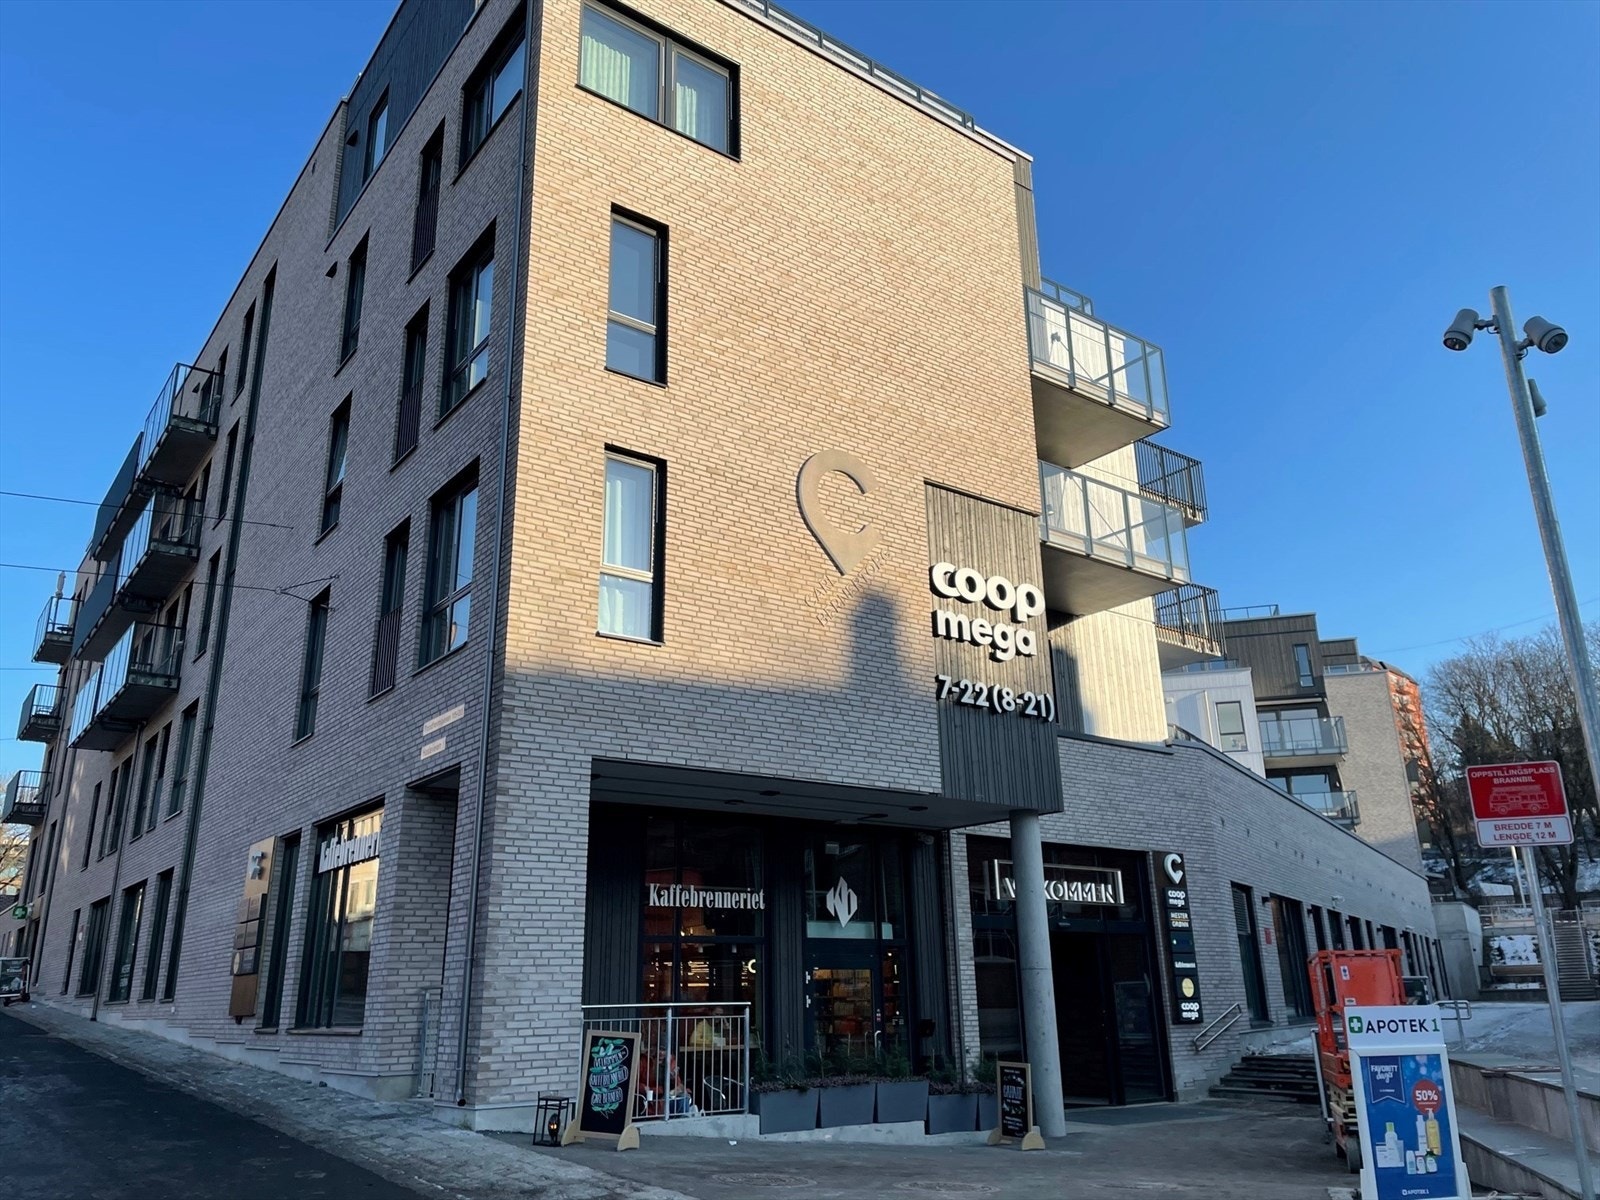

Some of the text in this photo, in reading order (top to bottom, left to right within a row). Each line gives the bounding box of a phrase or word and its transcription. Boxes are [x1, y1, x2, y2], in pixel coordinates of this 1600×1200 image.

[803, 574, 838, 608] CARL
[931, 561, 1046, 623] coop
[933, 609, 1038, 662] mega
[1470, 766, 1556, 778] OPPSTILLINGSPLASS
[1493, 776, 1536, 785] BRANNBIL
[1493, 821, 1553, 831] BREDDE 7 M
[1493, 831, 1557, 841] LENGDE 12 M
[1002, 876, 1116, 904] VKOMMEN
[1168, 890, 1186, 899] coop
[649, 883, 765, 910] Kaffebrenneriet
[1181, 1002, 1200, 1011] coop
[1365, 1018, 1441, 1034] APOTEK 1
[1415, 1089, 1438, 1101] 50%
